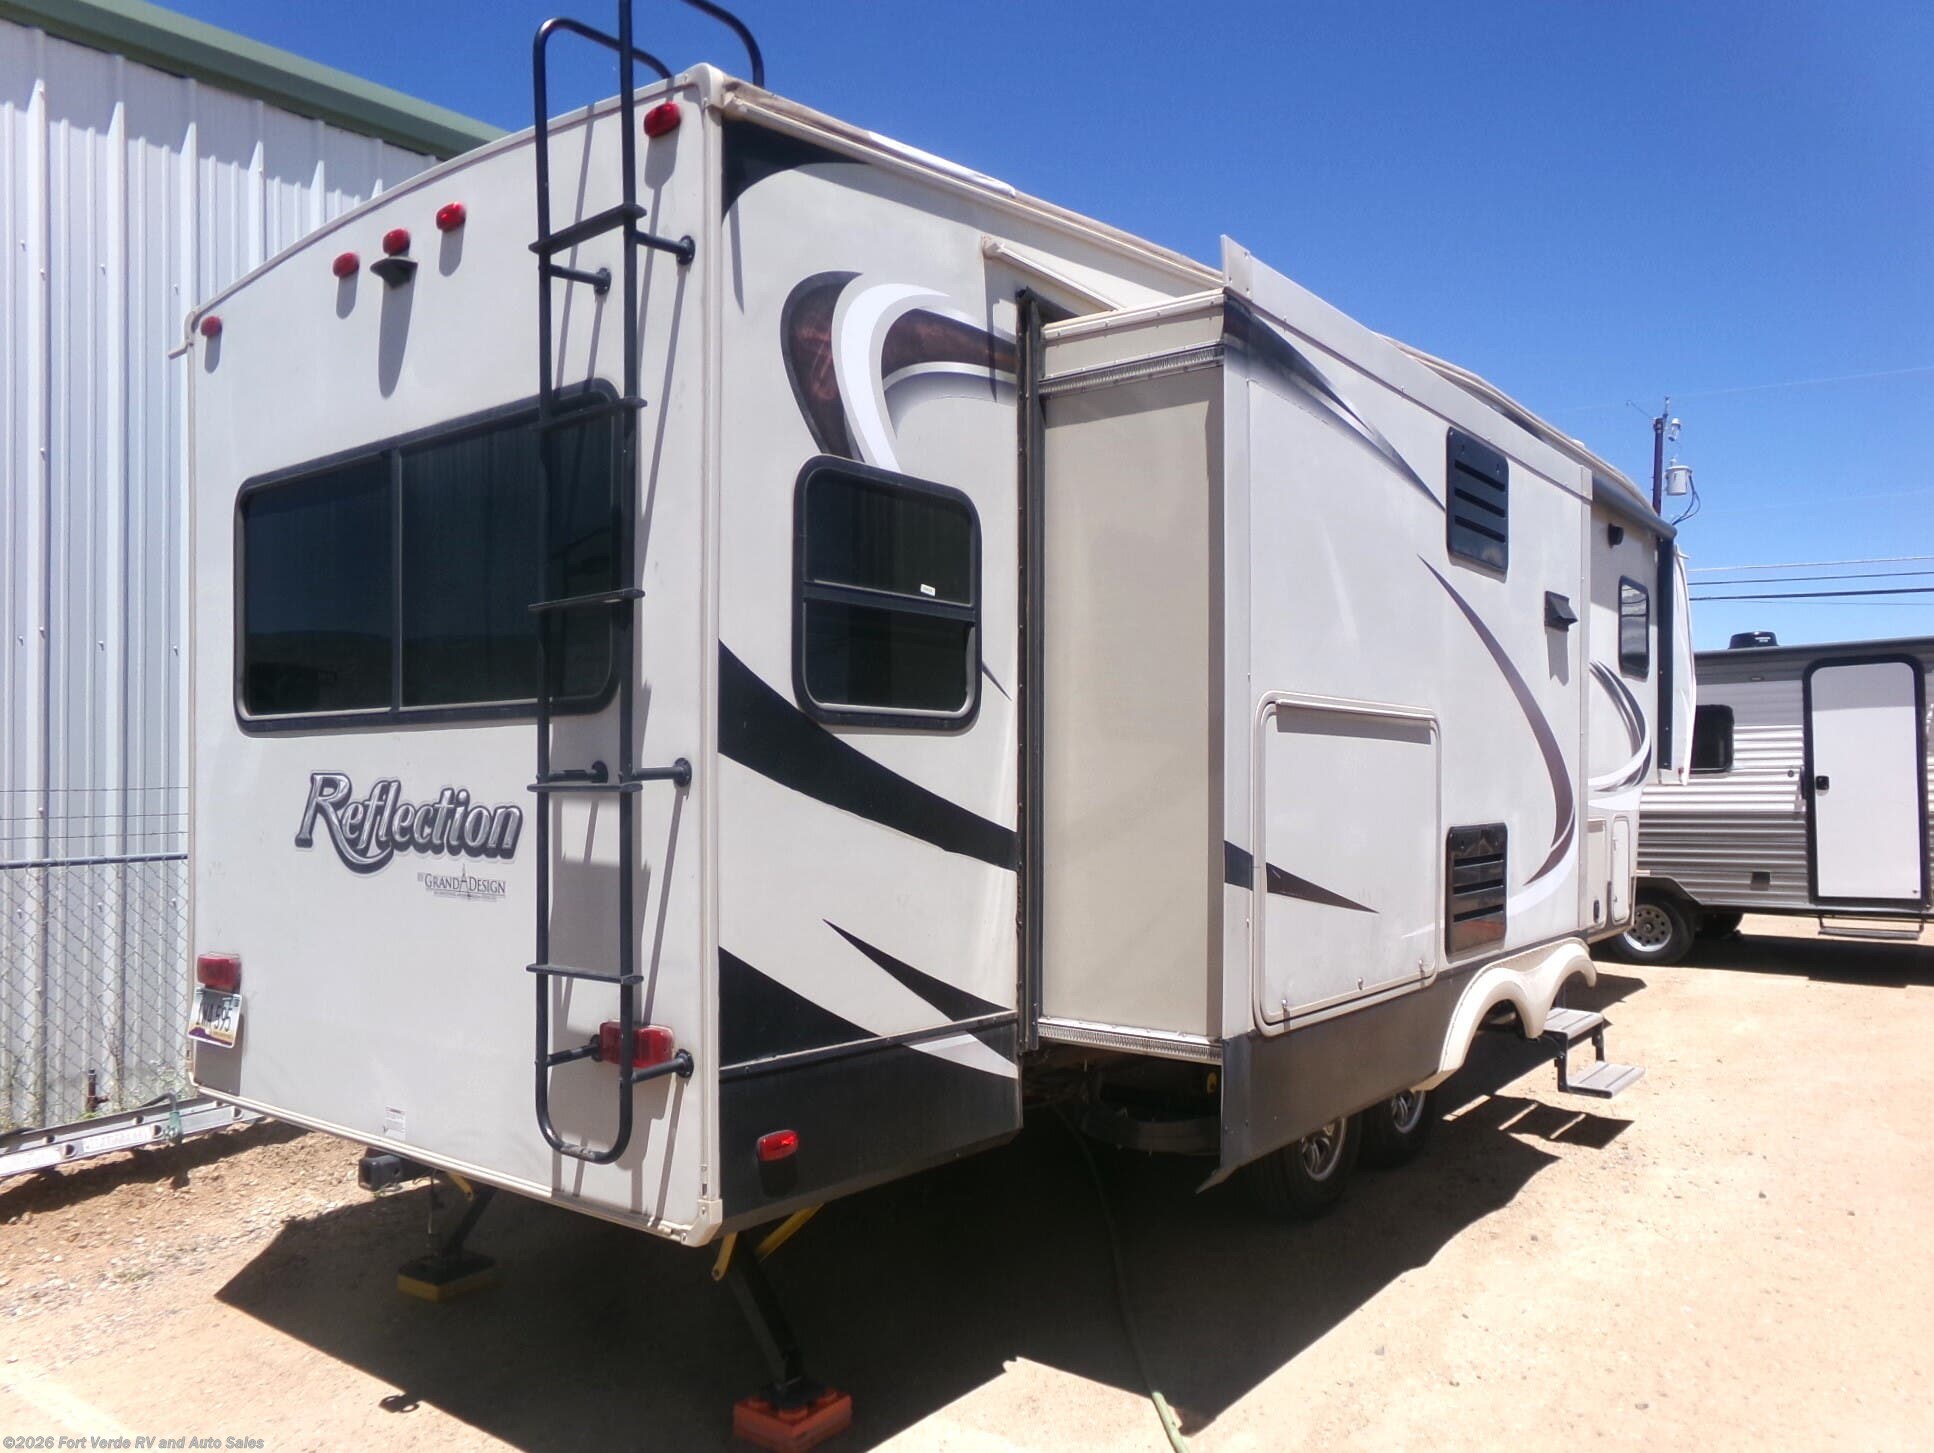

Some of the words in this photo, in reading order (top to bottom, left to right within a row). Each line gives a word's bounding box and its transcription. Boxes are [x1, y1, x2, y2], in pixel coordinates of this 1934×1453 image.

[295, 771, 523, 875] Reflection
[425, 873, 460, 890] GRAND
[469, 876, 506, 894] DESIGN
